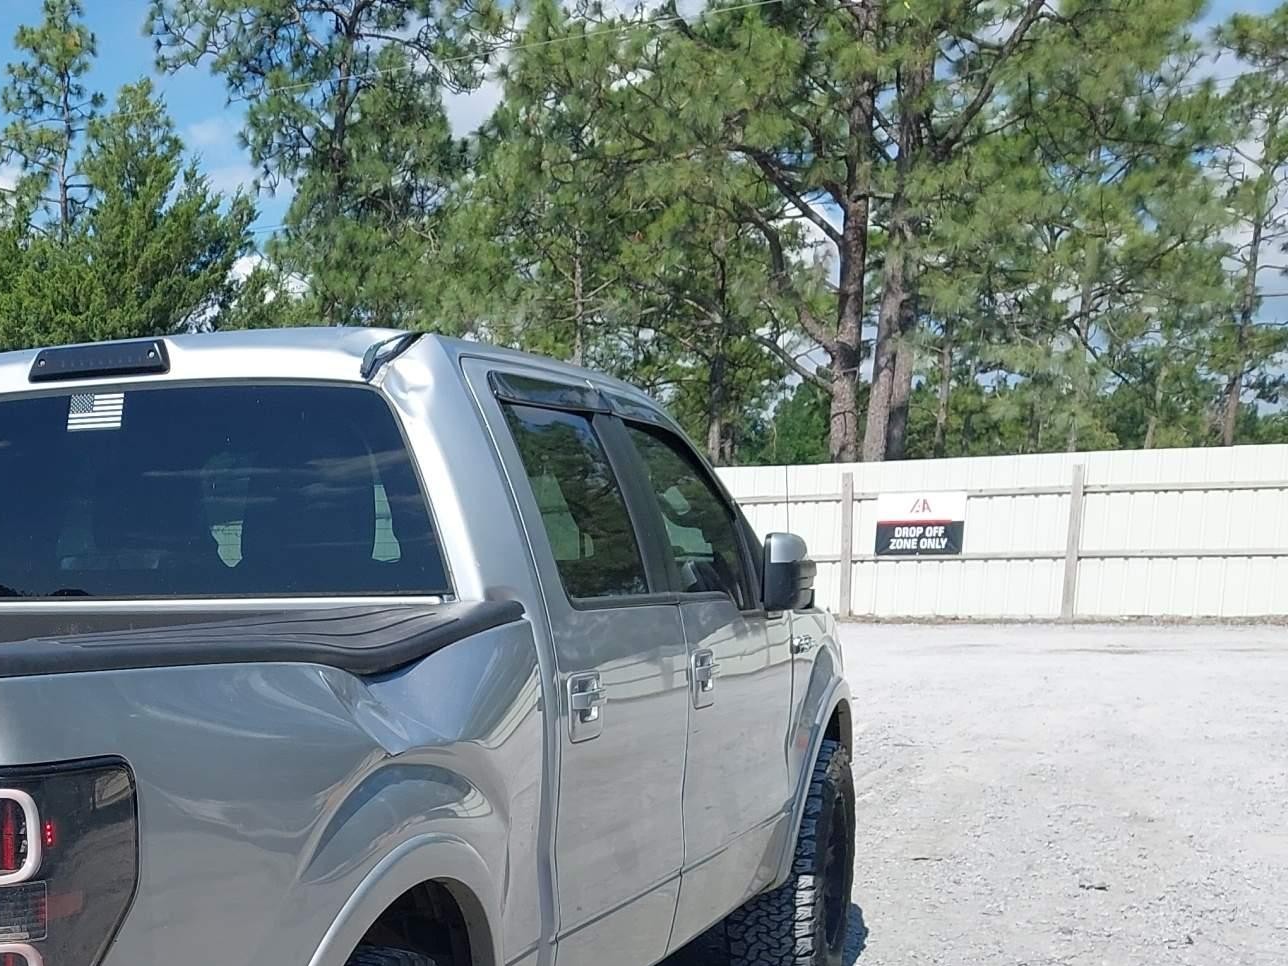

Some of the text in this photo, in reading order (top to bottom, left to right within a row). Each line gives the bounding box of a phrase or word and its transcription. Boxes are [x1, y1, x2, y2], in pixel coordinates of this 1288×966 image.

[894, 526, 945, 538] DROP OFF
[888, 537, 948, 550] ZONE ONLY
